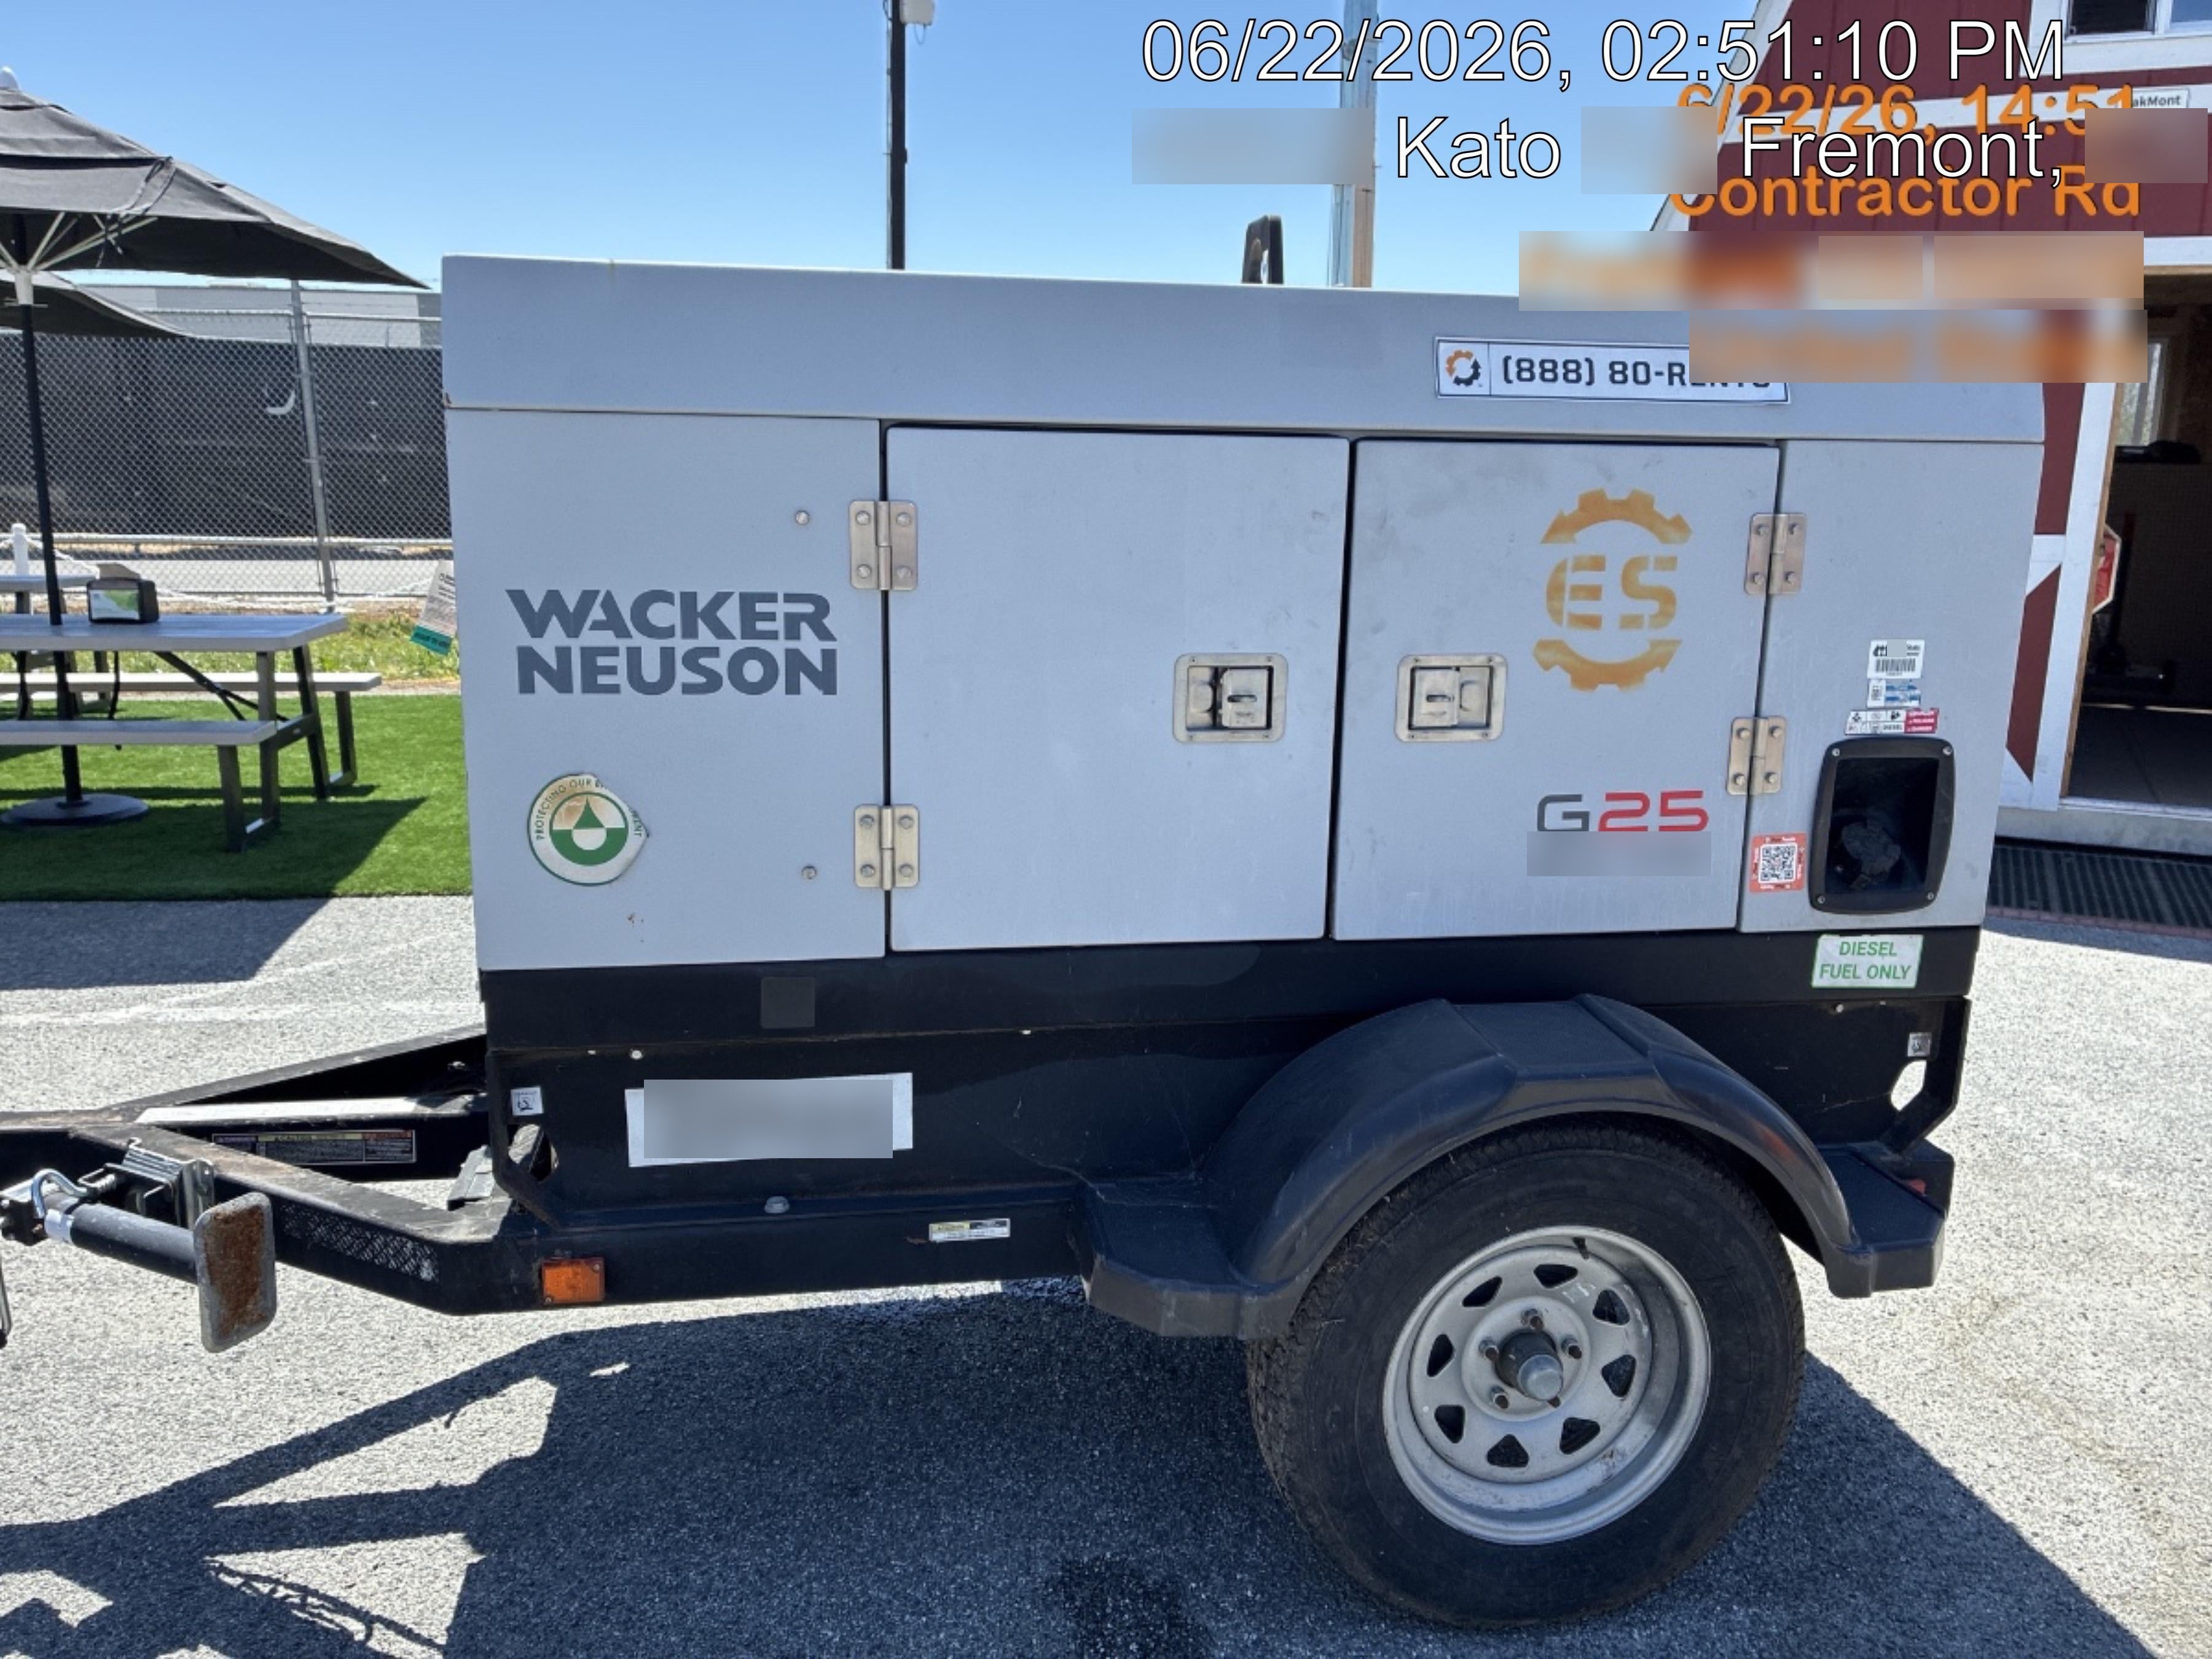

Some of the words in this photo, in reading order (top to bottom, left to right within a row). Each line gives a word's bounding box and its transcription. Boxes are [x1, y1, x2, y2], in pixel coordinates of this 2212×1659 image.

[1503, 355, 1595, 386] (888)
[1545, 554, 1679, 631] ES
[506, 589, 837, 641] WACKER
[517, 646, 837, 696] NEUSON
[1537, 790, 1709, 832] G25
[1839, 941, 1897, 957] DIESEL
[1819, 963, 1862, 979] FUEL
[1867, 964, 1912, 980] ONLY
